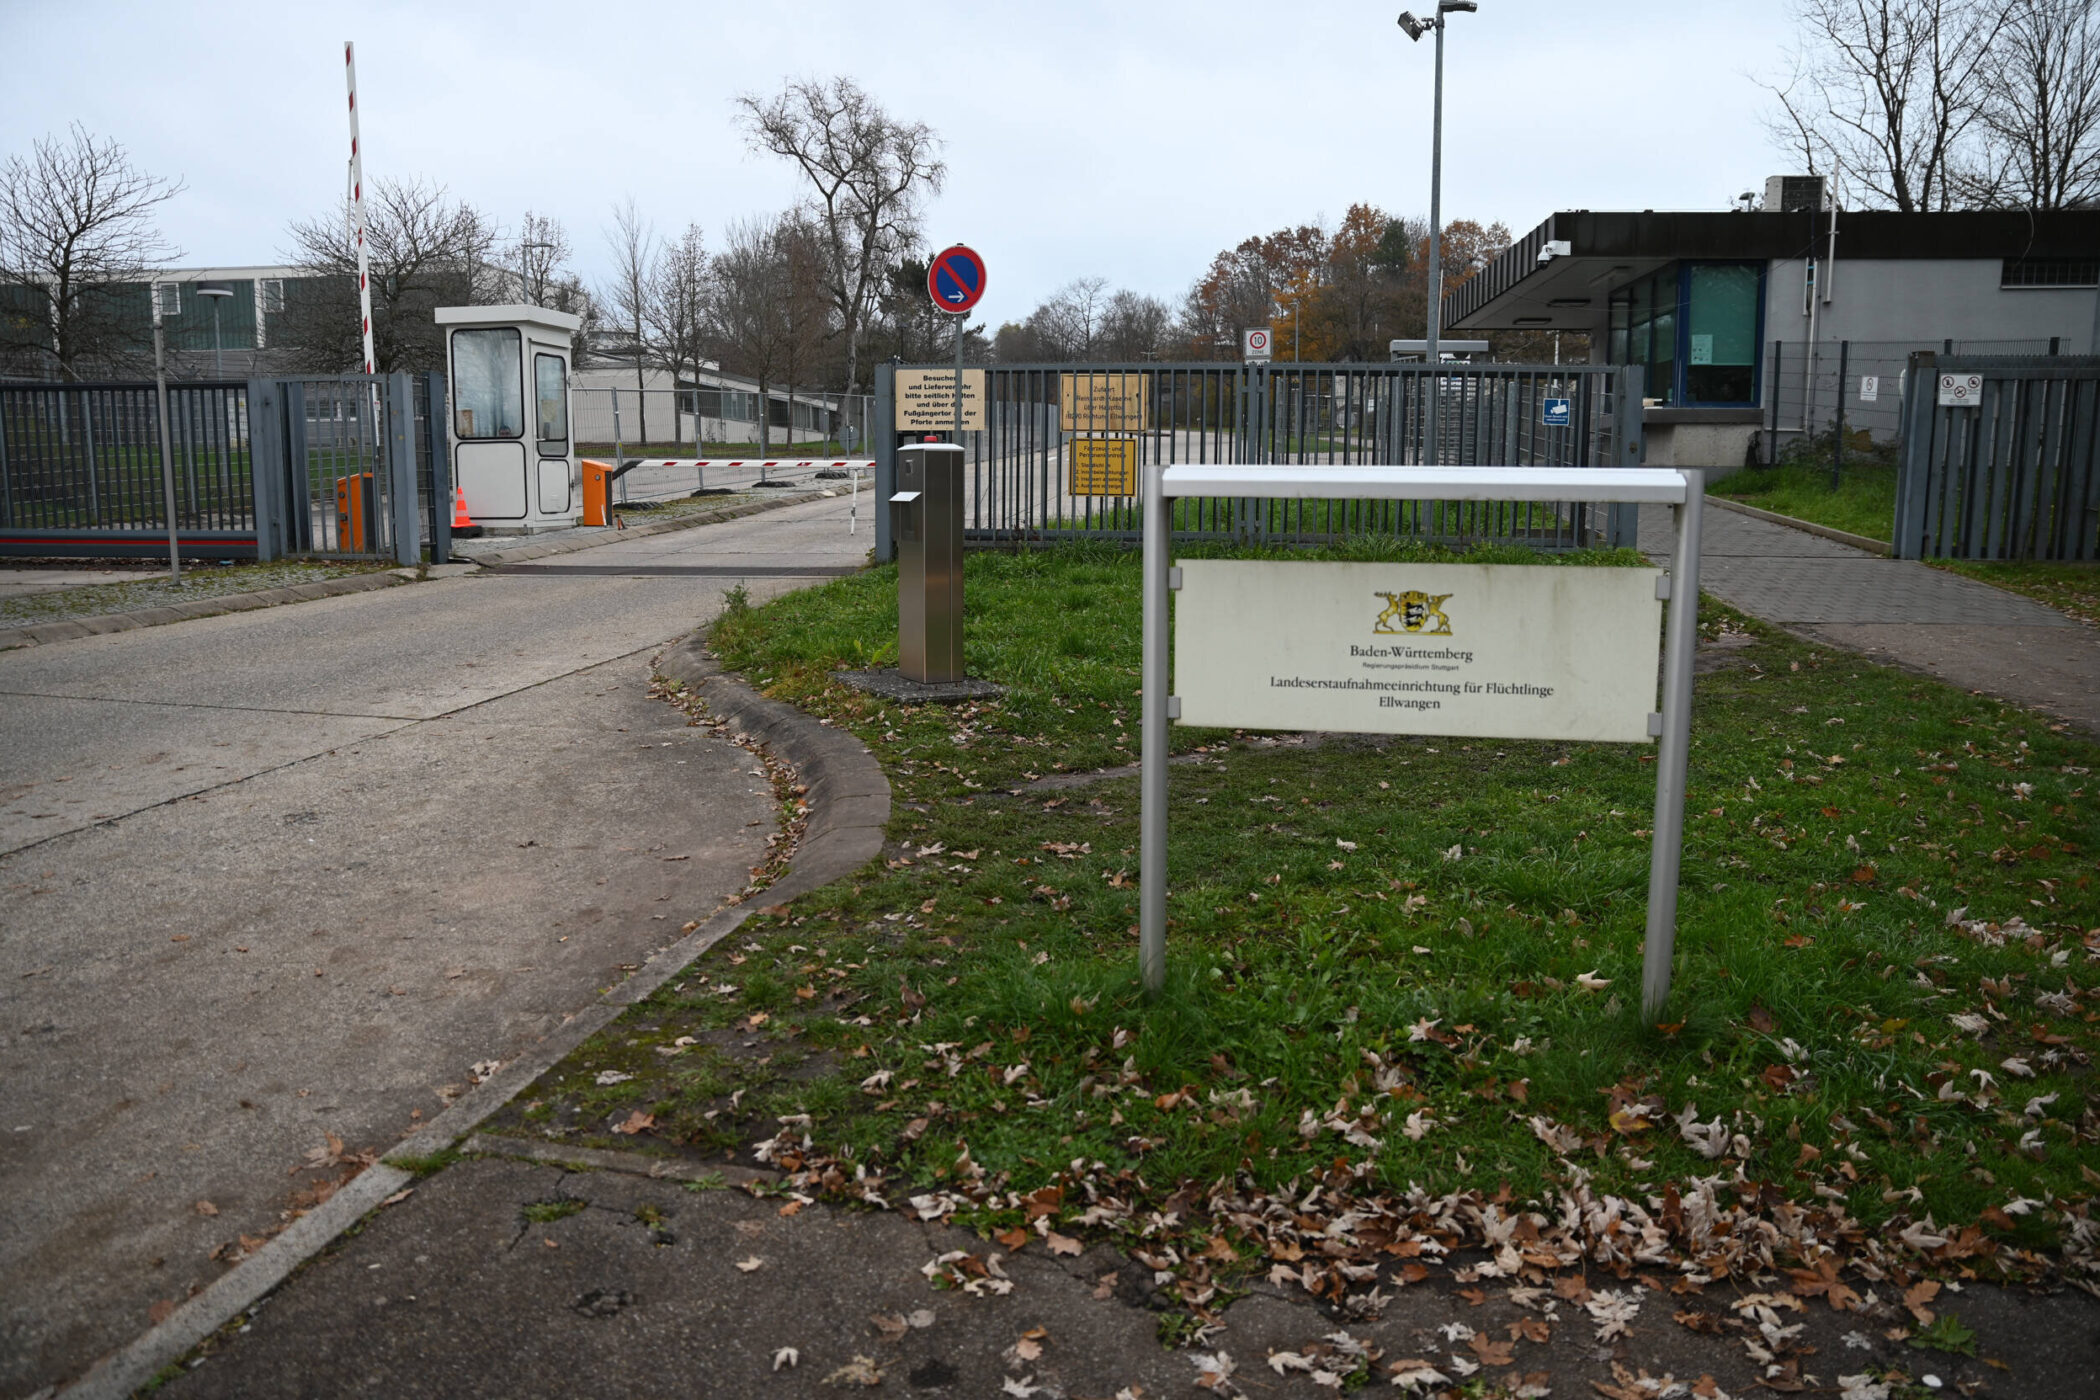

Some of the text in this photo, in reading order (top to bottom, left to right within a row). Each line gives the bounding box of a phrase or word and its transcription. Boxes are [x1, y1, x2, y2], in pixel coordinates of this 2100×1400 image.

[1254, 336, 1262, 344] 10
[1350, 644, 1473, 663] Baden-Württemberg
[1362, 662, 1460, 672] Regierungspräsidium Stuttgart
[1270, 676, 1554, 698] Landeserstaufnahmeeinrichtung für Flüchtlinge
[1379, 696, 1441, 711] Ellwangen
